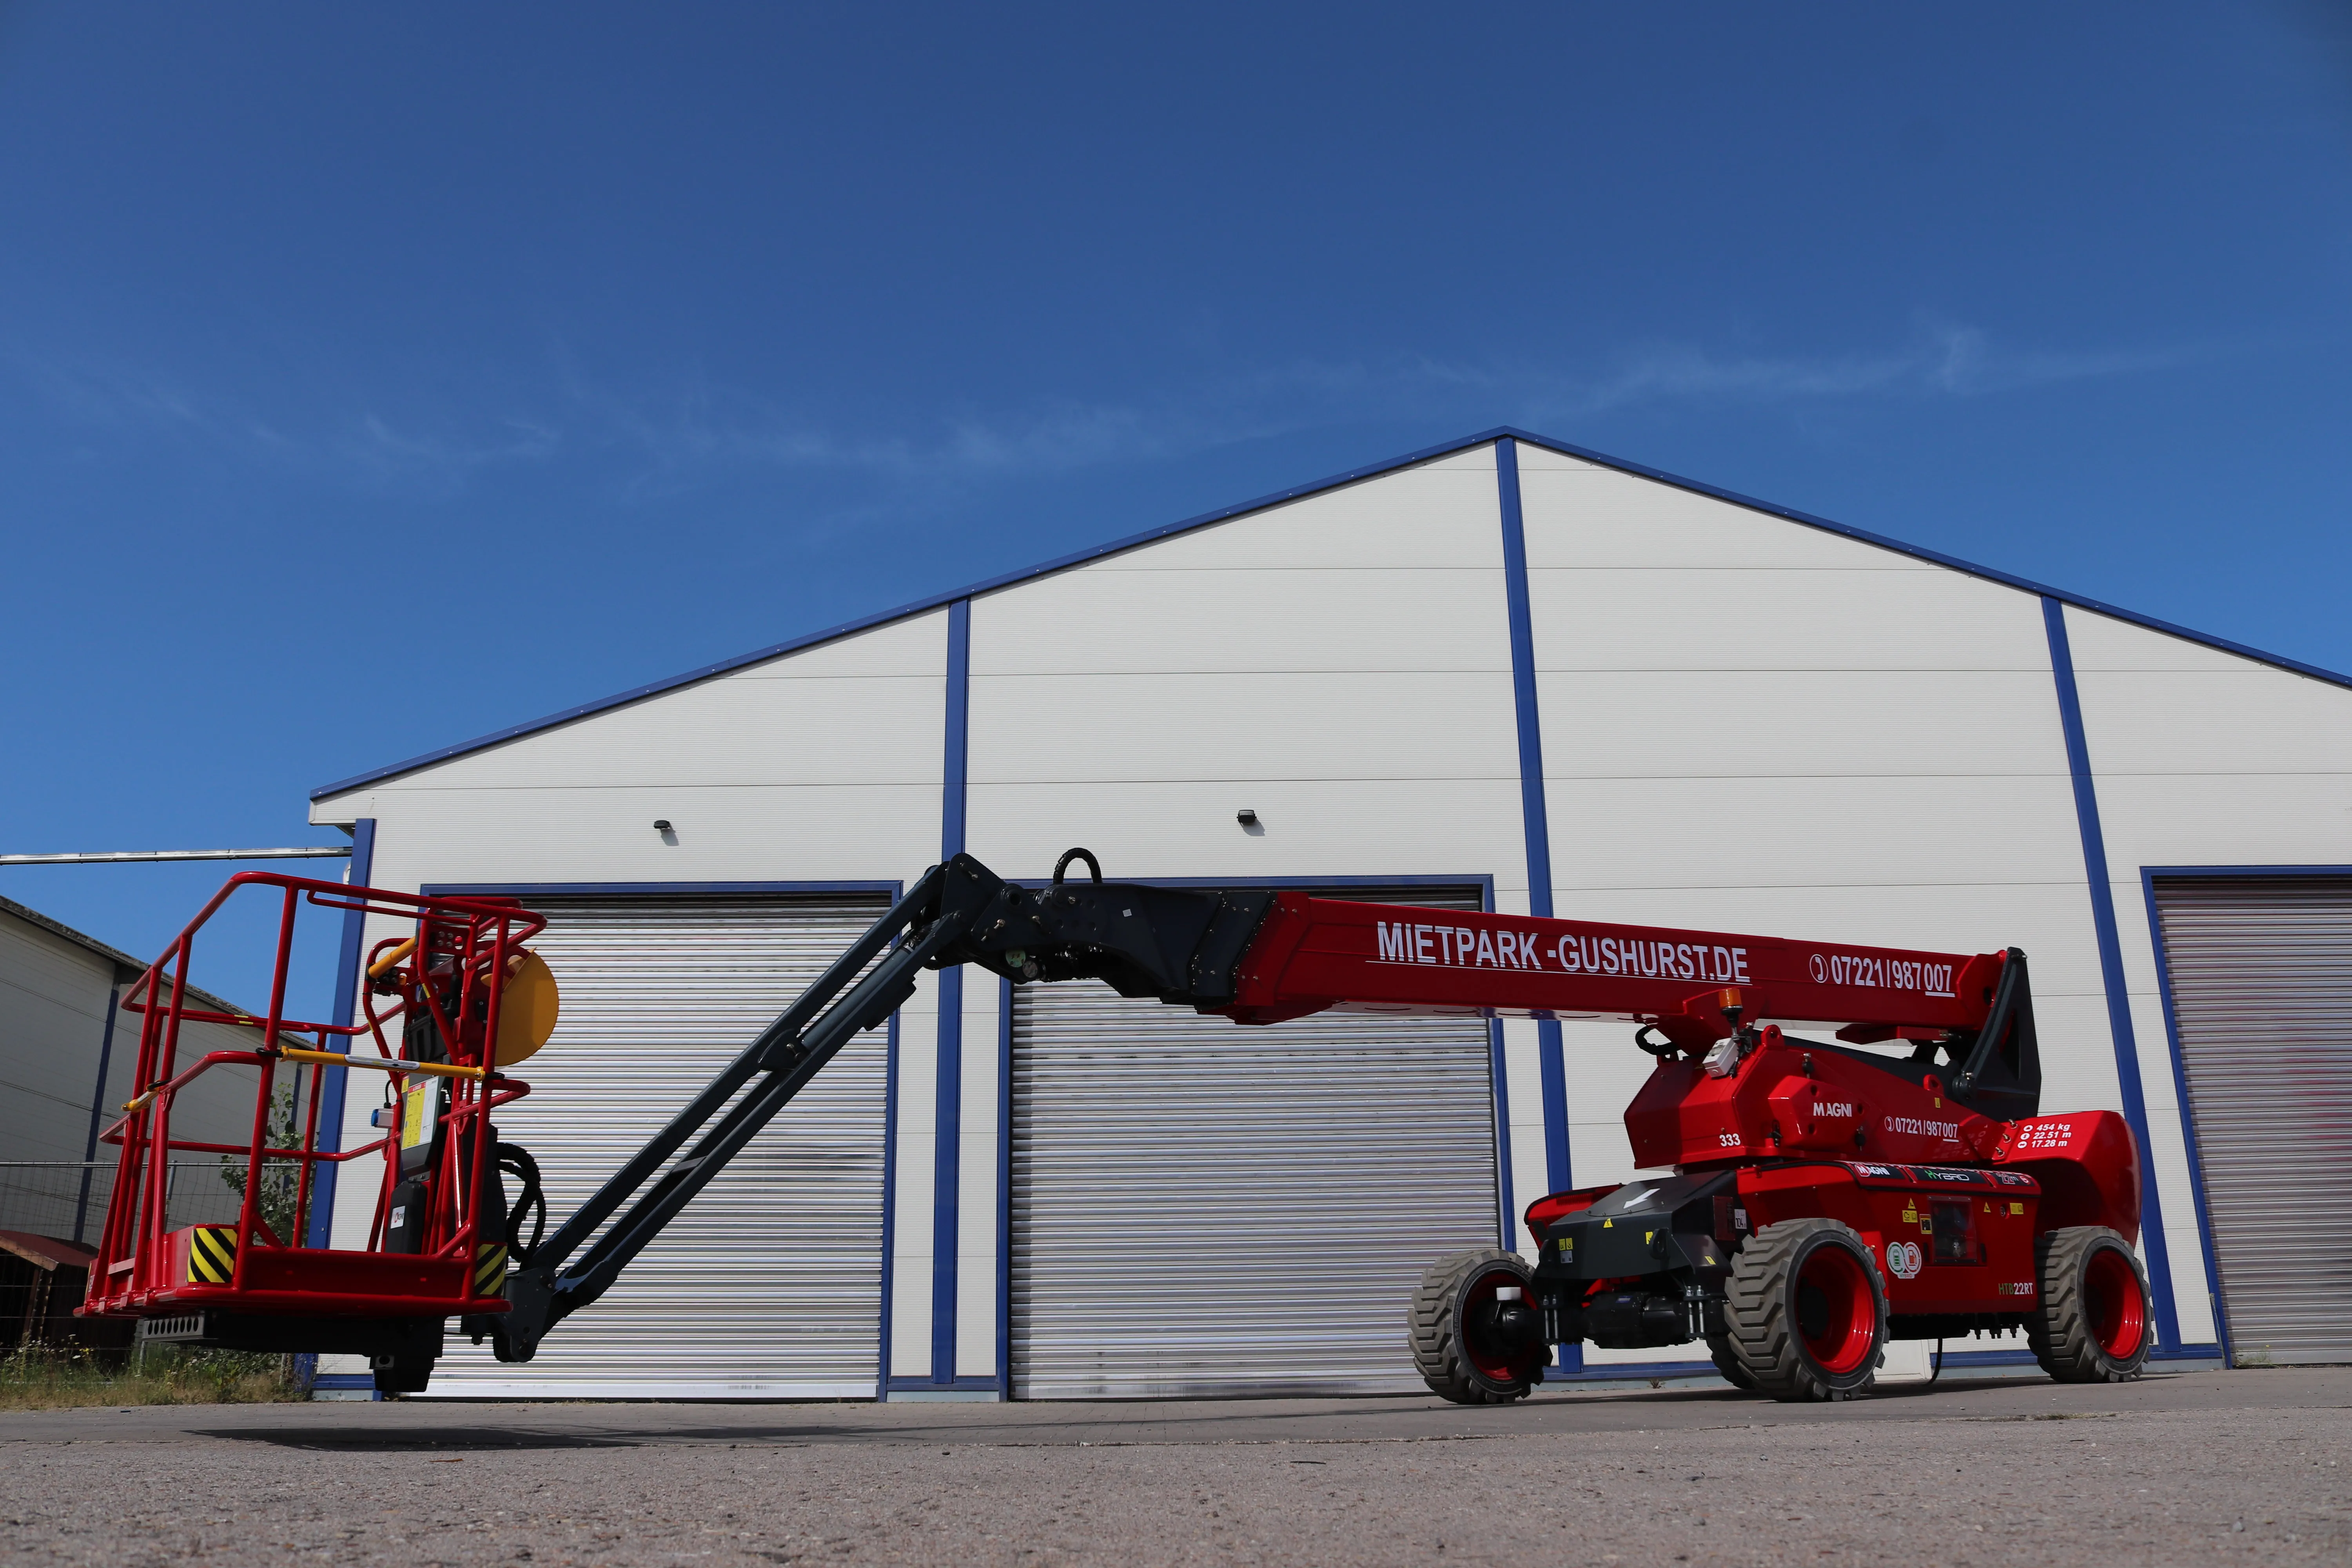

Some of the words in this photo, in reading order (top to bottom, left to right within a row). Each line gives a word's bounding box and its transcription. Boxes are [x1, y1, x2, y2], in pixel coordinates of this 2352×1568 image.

[1813, 1102, 1852, 1117] MAGNI
[2057, 1123, 2071, 1131] kg
[1719, 1133, 1740, 1147] 333
[2033, 1131, 2059, 1140] 22.51
[2031, 1139, 2056, 1148] 17.28
[1856, 1165, 1890, 1176] MAGNI
[1998, 1282, 2033, 1295] HTB22RT
